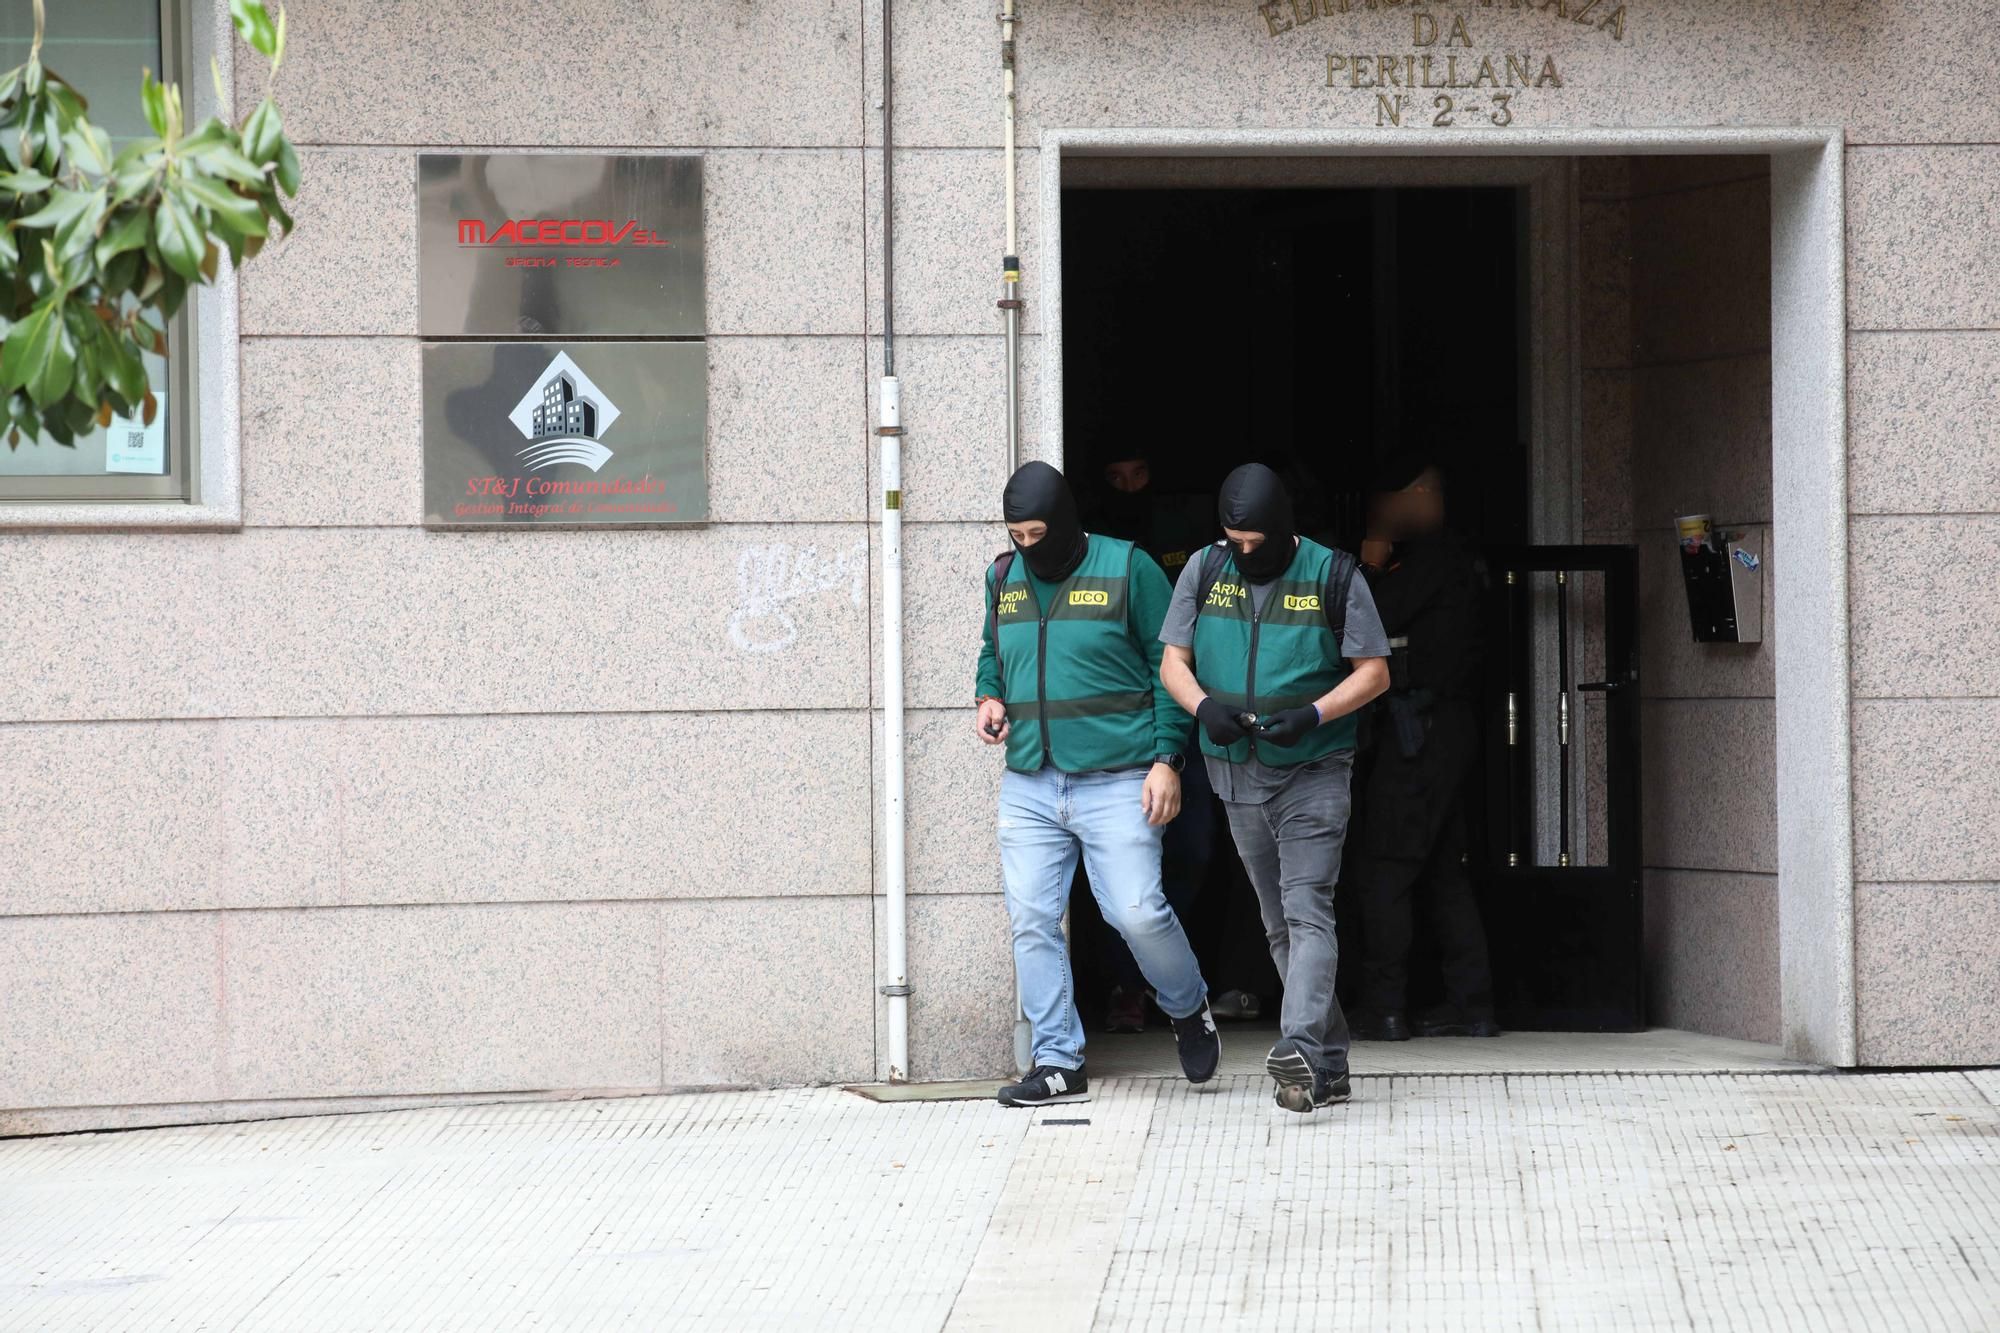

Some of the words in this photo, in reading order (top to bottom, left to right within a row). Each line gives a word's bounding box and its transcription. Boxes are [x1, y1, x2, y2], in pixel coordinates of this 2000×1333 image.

[1412, 12, 1473, 47] DA
[1325, 53, 1562, 88] PERILLANA
[458, 219, 637, 244] MACECOV
[465, 475, 520, 498] ST&J
[1073, 592, 1105, 603] UCO
[1205, 592, 1233, 608] CIVL
[1211, 581, 1246, 599] ARDIA
[1288, 597, 1319, 608] UCO
